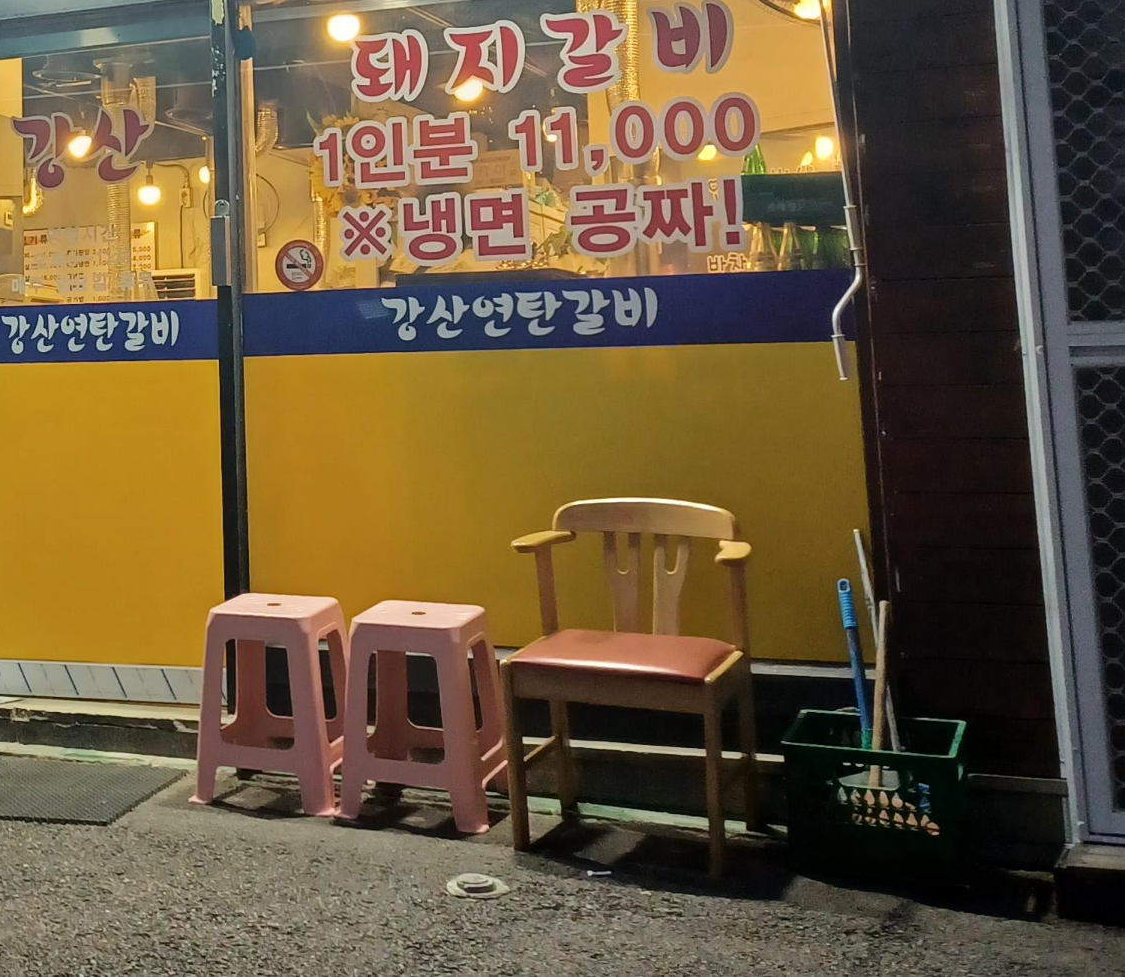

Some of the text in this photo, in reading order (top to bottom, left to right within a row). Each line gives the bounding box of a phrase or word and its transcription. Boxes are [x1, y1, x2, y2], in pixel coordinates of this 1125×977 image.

[351, 0, 735, 102] 돼지갈비
[11, 106, 153, 190] 강산
[315, 93, 760, 188] 1인분 11,000
[567, 177, 745, 258] 공짜!
[1, 310, 179, 354] 강산연탄갈비
[381, 287, 658, 341] 강산연탄갈비
